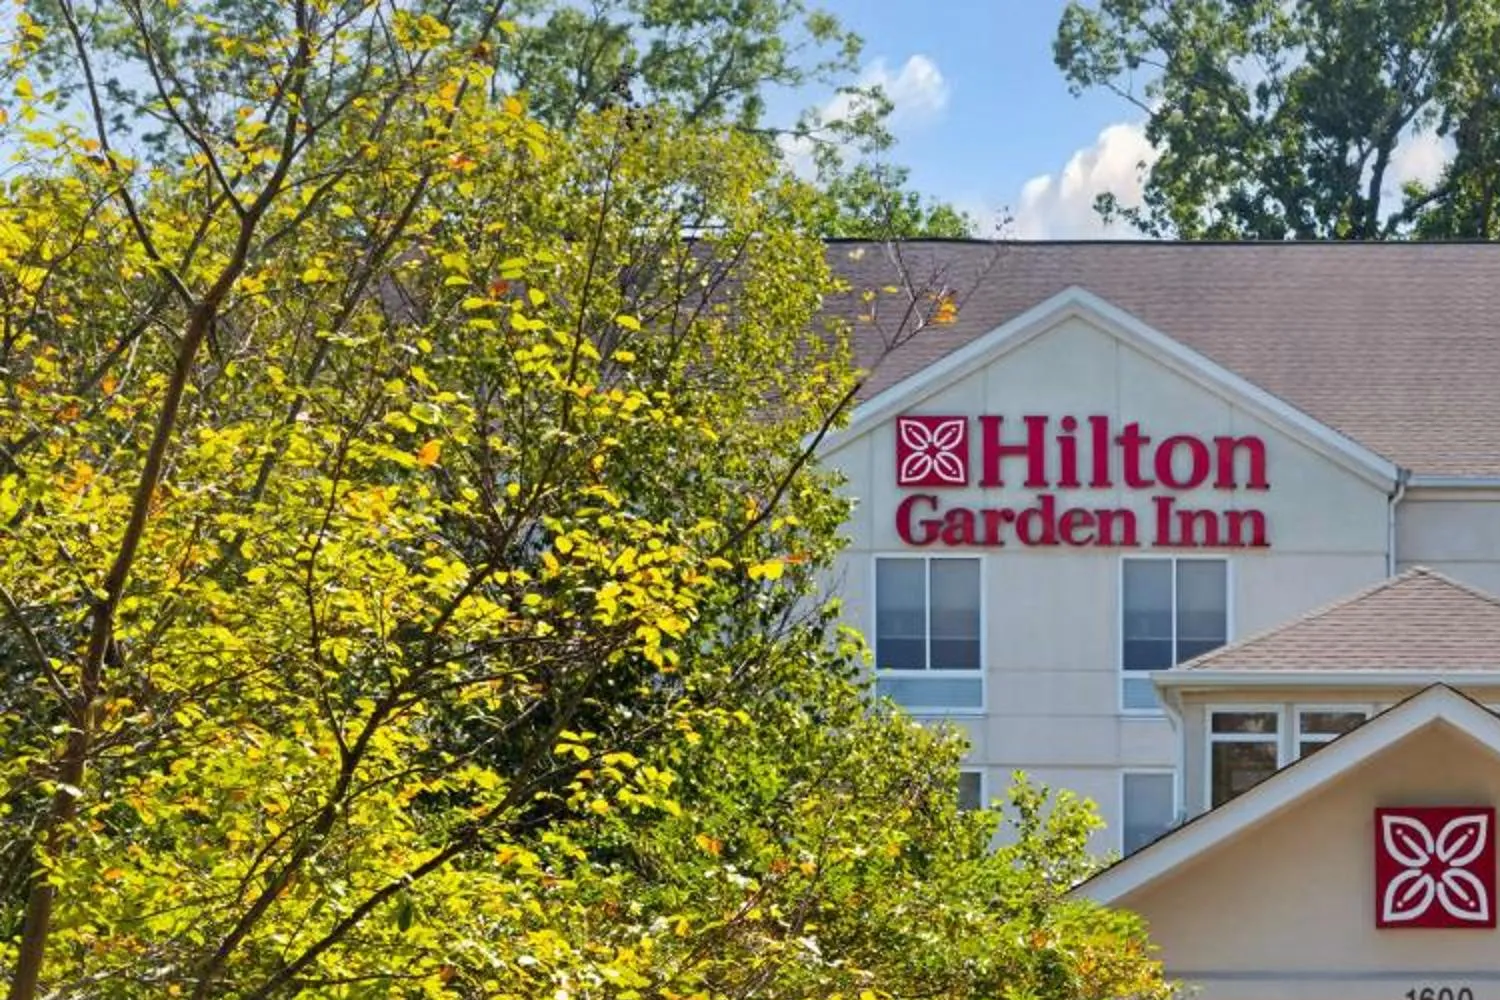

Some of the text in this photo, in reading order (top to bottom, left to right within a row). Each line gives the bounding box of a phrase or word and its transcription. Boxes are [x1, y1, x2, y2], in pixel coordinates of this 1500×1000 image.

[979, 415, 1271, 490] Hilton
[895, 494, 1271, 547] Garden Inn
